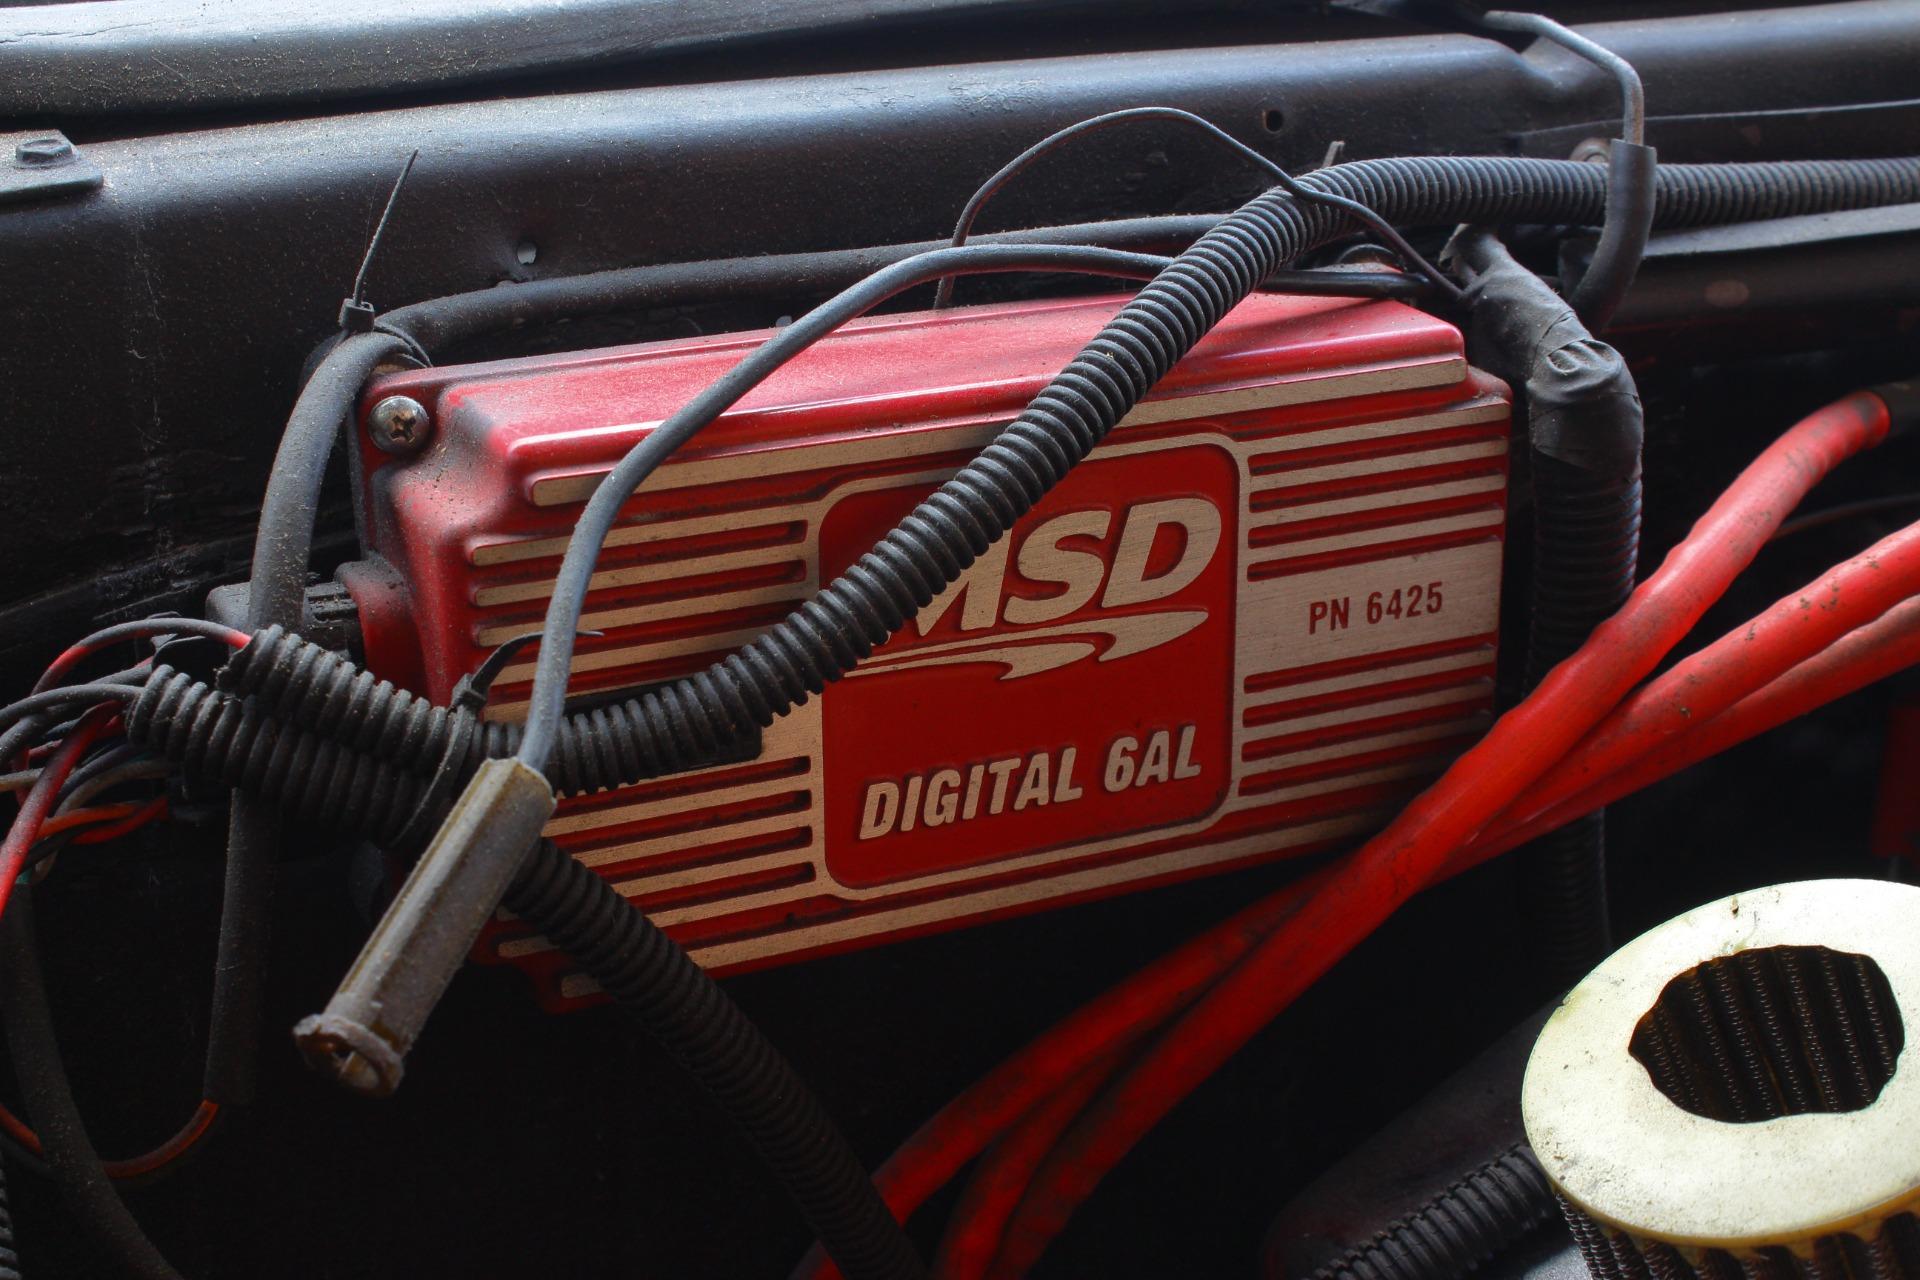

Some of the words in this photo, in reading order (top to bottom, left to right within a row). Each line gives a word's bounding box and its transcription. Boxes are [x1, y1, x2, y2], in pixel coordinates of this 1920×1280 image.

[1309, 597, 1350, 635] PN
[1366, 580, 1443, 625] 6425
[859, 747, 1082, 840] DIGITAL
[1104, 725, 1201, 793] 6AL
